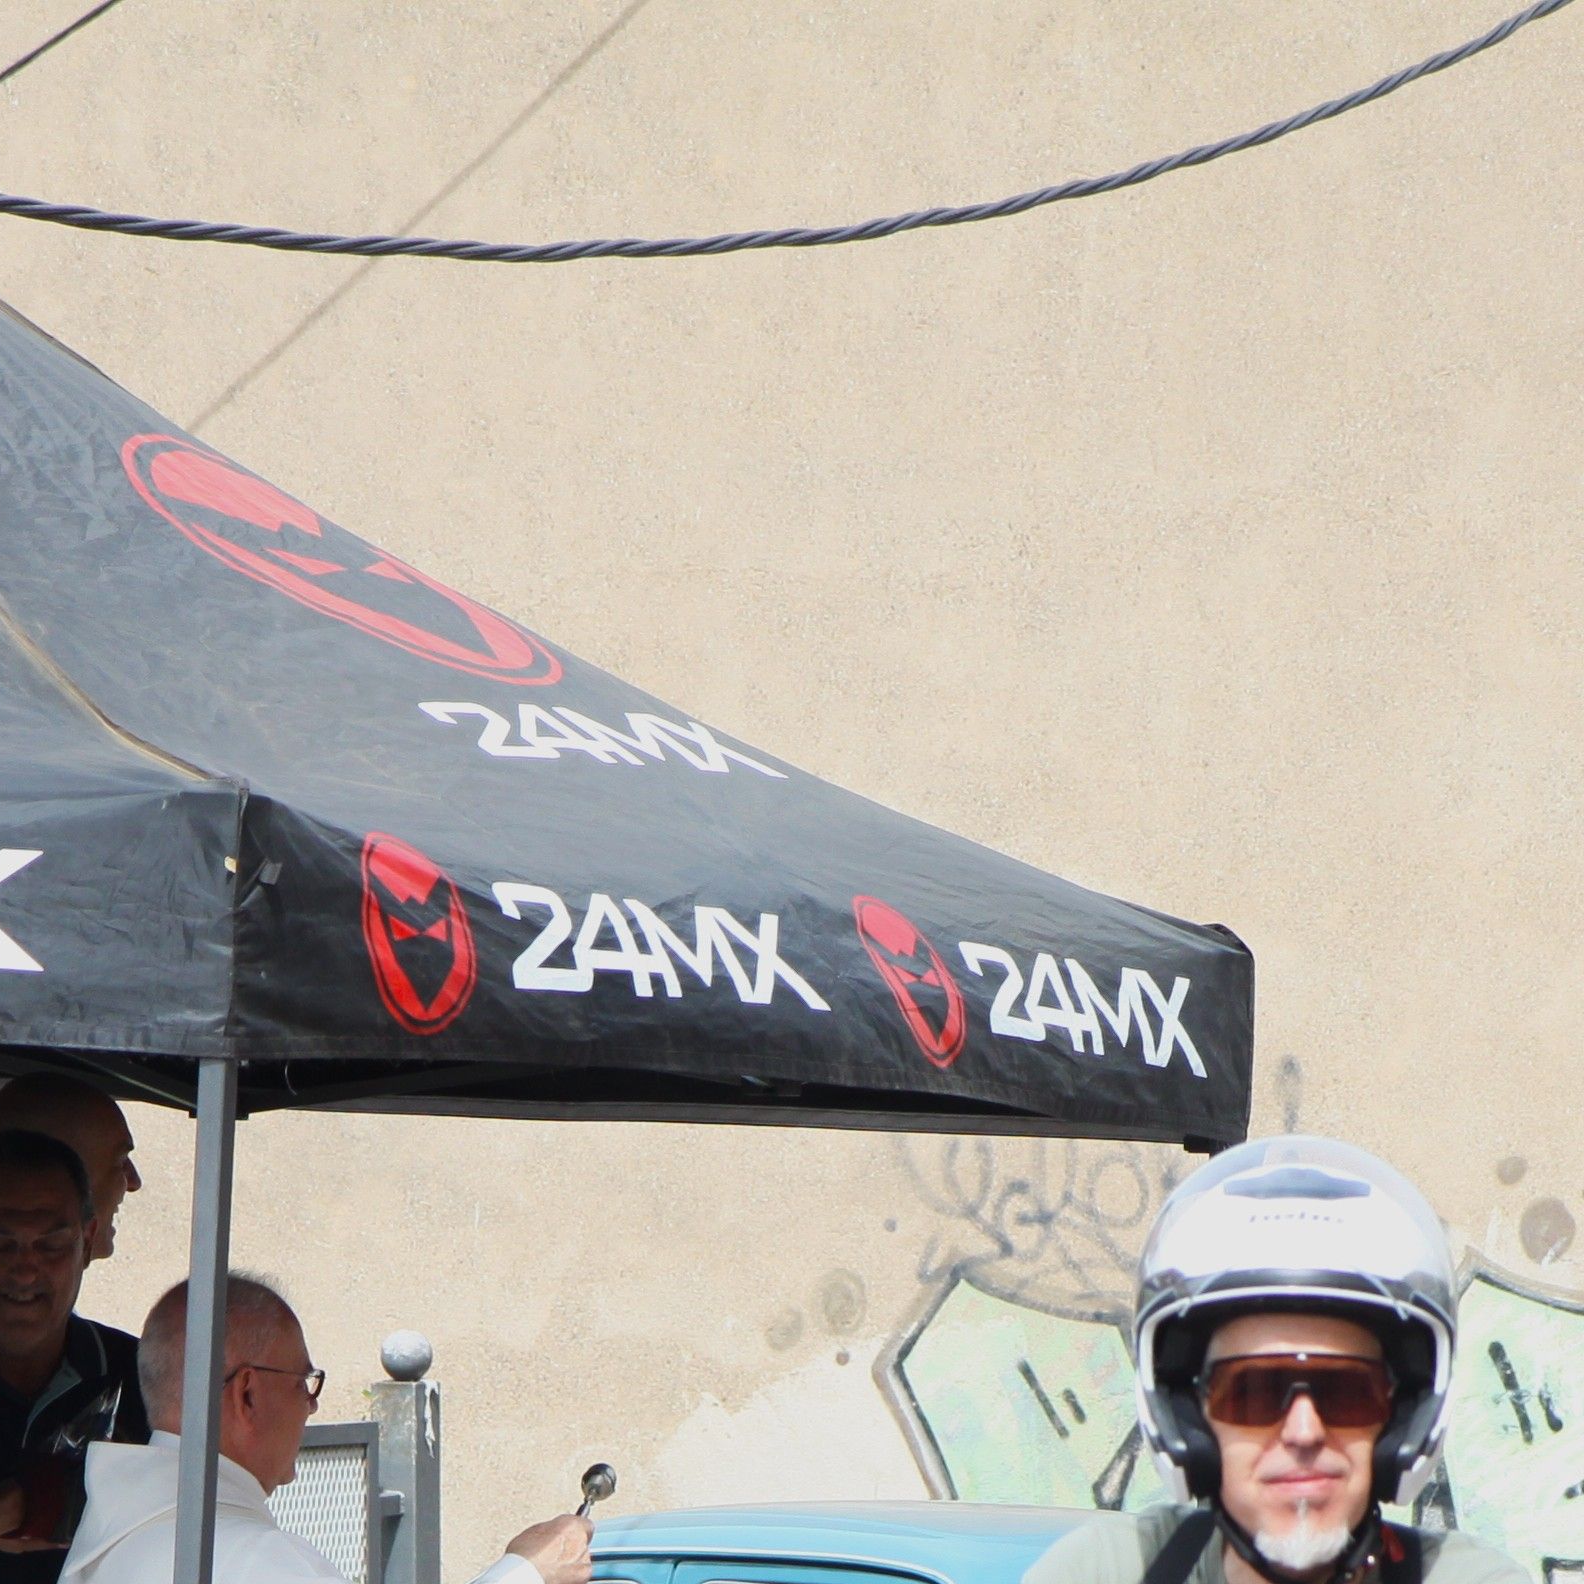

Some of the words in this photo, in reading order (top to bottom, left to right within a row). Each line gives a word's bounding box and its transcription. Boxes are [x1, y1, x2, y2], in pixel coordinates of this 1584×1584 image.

[418, 701, 789, 779] 24MX
[491, 882, 832, 1012] 24MX
[958, 941, 1207, 1077] 24MX
